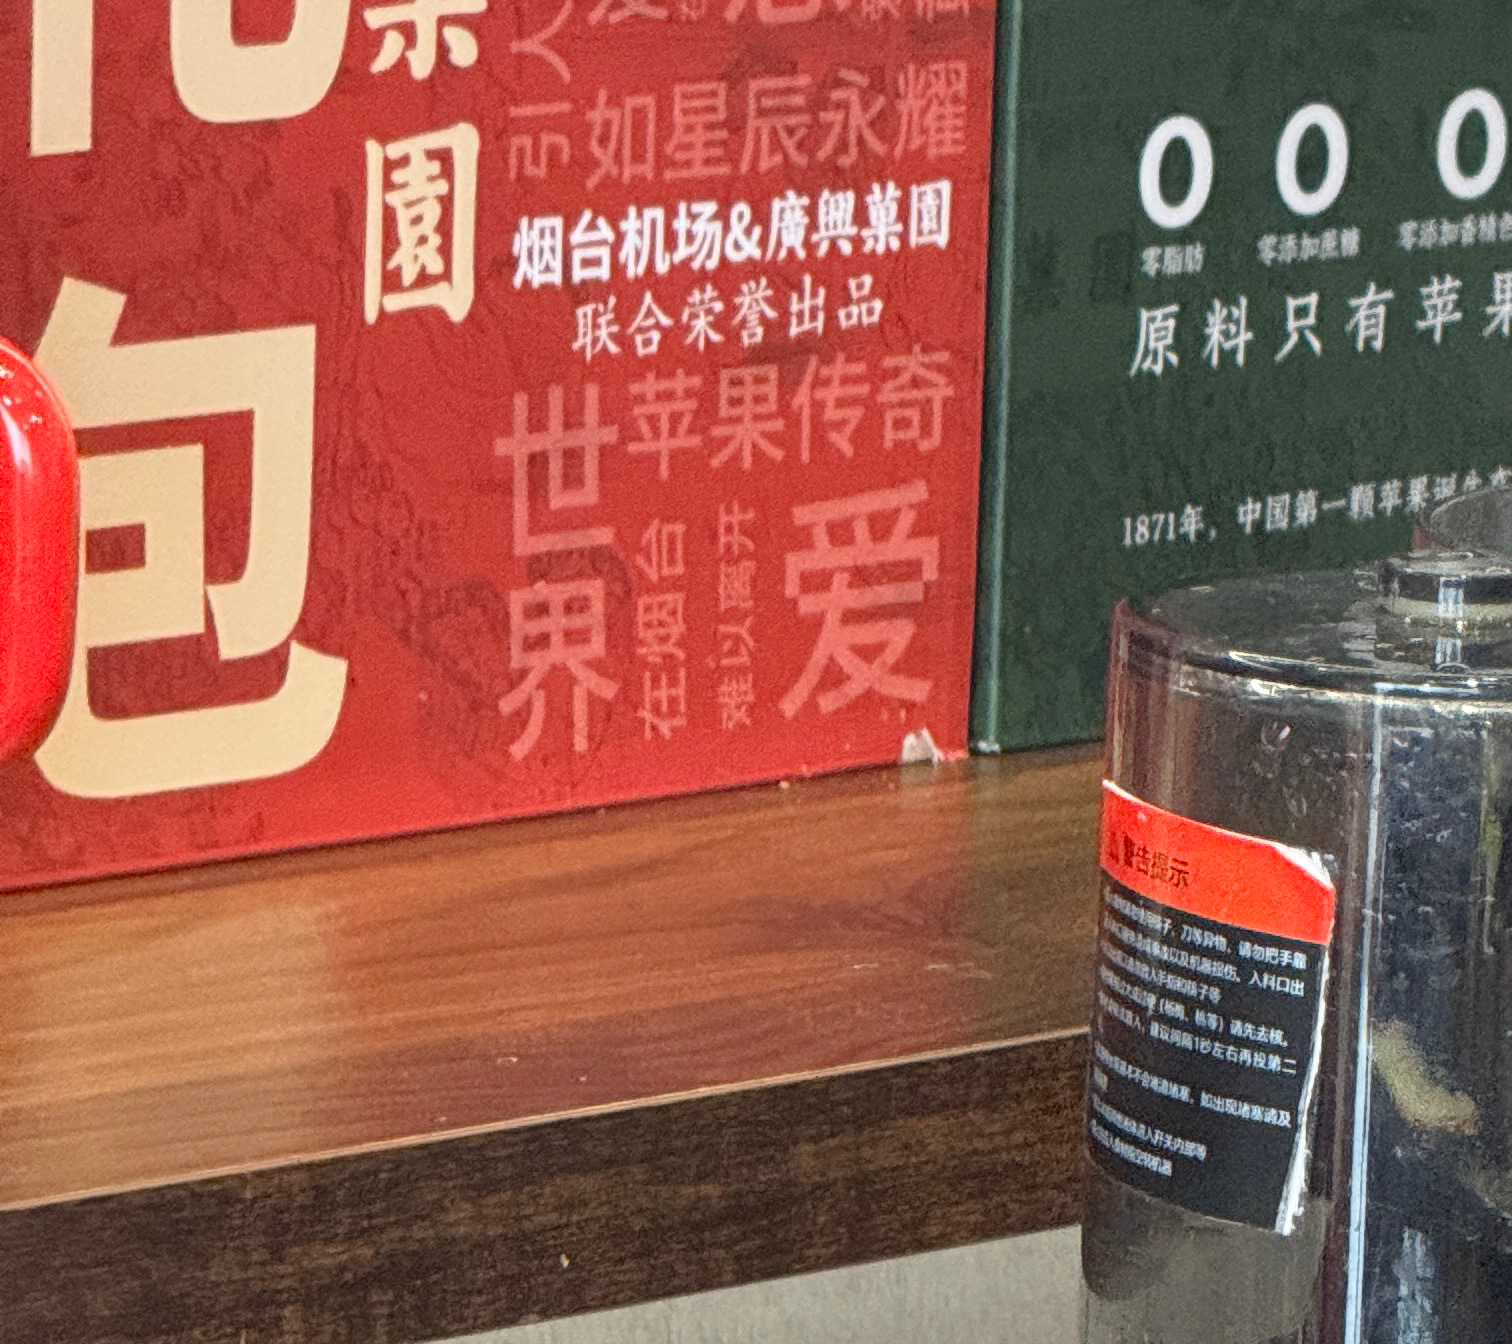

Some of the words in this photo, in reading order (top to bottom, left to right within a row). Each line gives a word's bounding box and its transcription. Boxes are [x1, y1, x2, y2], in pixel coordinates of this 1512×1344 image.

[585, 60, 968, 190] 如星辰永耀
[1139, 115, 1214, 229] 0
[1276, 103, 1349, 216] 0
[1437, 87, 1507, 200] 0
[571, 272, 884, 363] 联合荣誉出品
[627, 343, 955, 480] 苹果传奇
[493, 382, 620, 760] 世界
[635, 517, 688, 741] 在烟台
[706, 500, 756, 730] 难以离开
[778, 478, 940, 718] 爱
